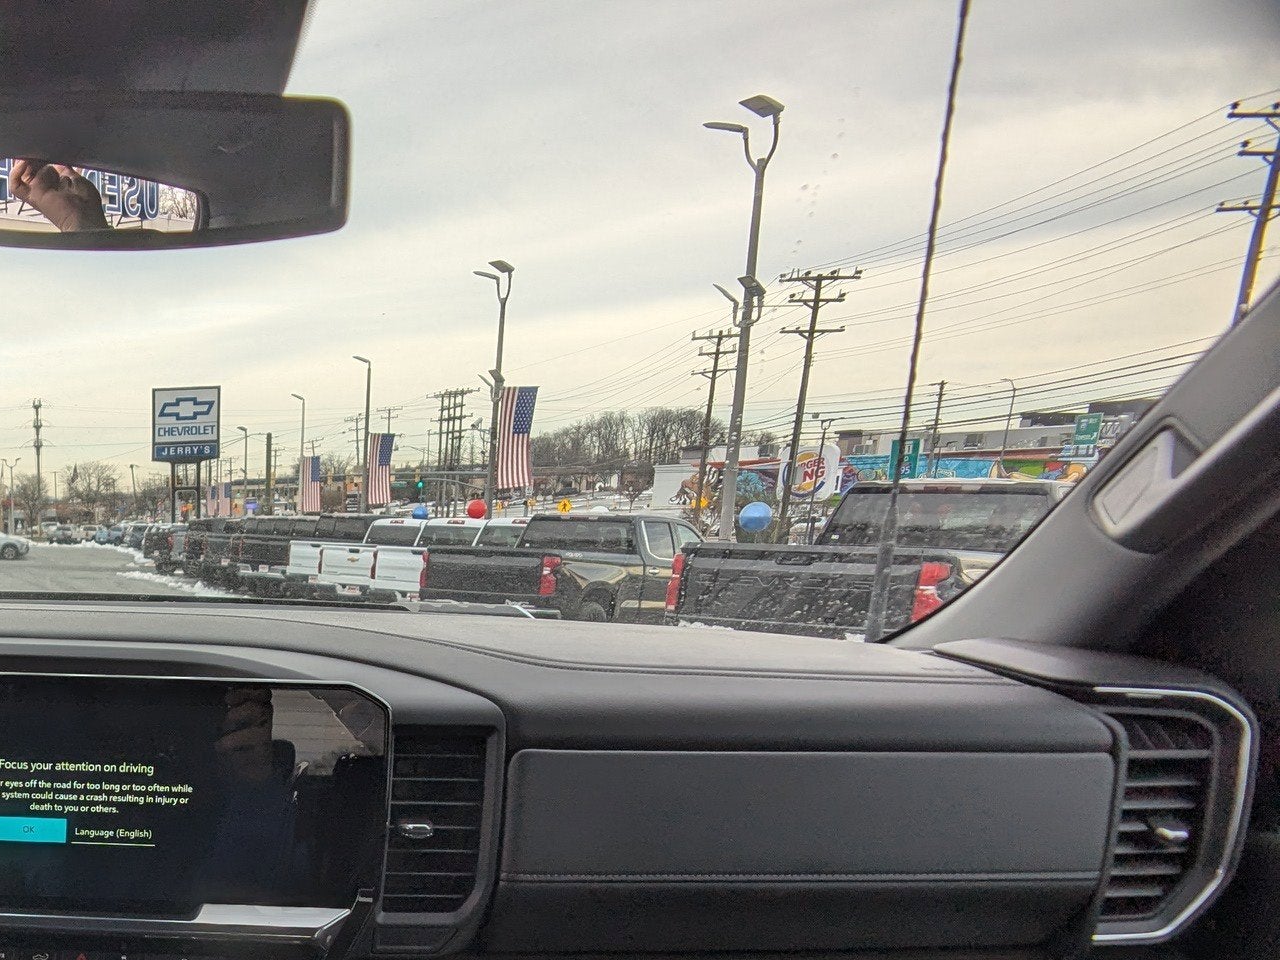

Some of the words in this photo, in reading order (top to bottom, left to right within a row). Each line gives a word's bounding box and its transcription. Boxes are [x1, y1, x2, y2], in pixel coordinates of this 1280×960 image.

[157, 424, 216, 437] CHEVROLET
[161, 445, 211, 456] JERRY'S
[30, 761, 53, 772] your
[55, 762, 102, 772] attention
[103, 764, 117, 772] on
[119, 762, 154, 776] driving
[5, 781, 23, 789] eyes
[25, 779, 38, 788] off
[38, 780, 51, 788] the
[53, 781, 71, 789] road
[73, 781, 85, 789] for
[86, 782, 100, 790] too
[102, 781, 120, 792] long
[132, 783, 146, 792] too
[147, 783, 170, 792] often
[171, 784, 193, 793] while
[1, 791, 30, 800] system
[31, 791, 54, 800] could
[85, 793, 108, 802] crash
[109, 794, 144, 805] resulting
[146, 795, 154, 803] in
[155, 796, 178, 806] injury
[29, 802, 53, 811] death
[54, 803, 63, 811] to
[63, 805, 79, 813] you
[90, 804, 119, 813] others.
[22, 825, 35, 834] OK
[75, 828, 115, 838] Language
[116, 828, 153, 840] (English)
